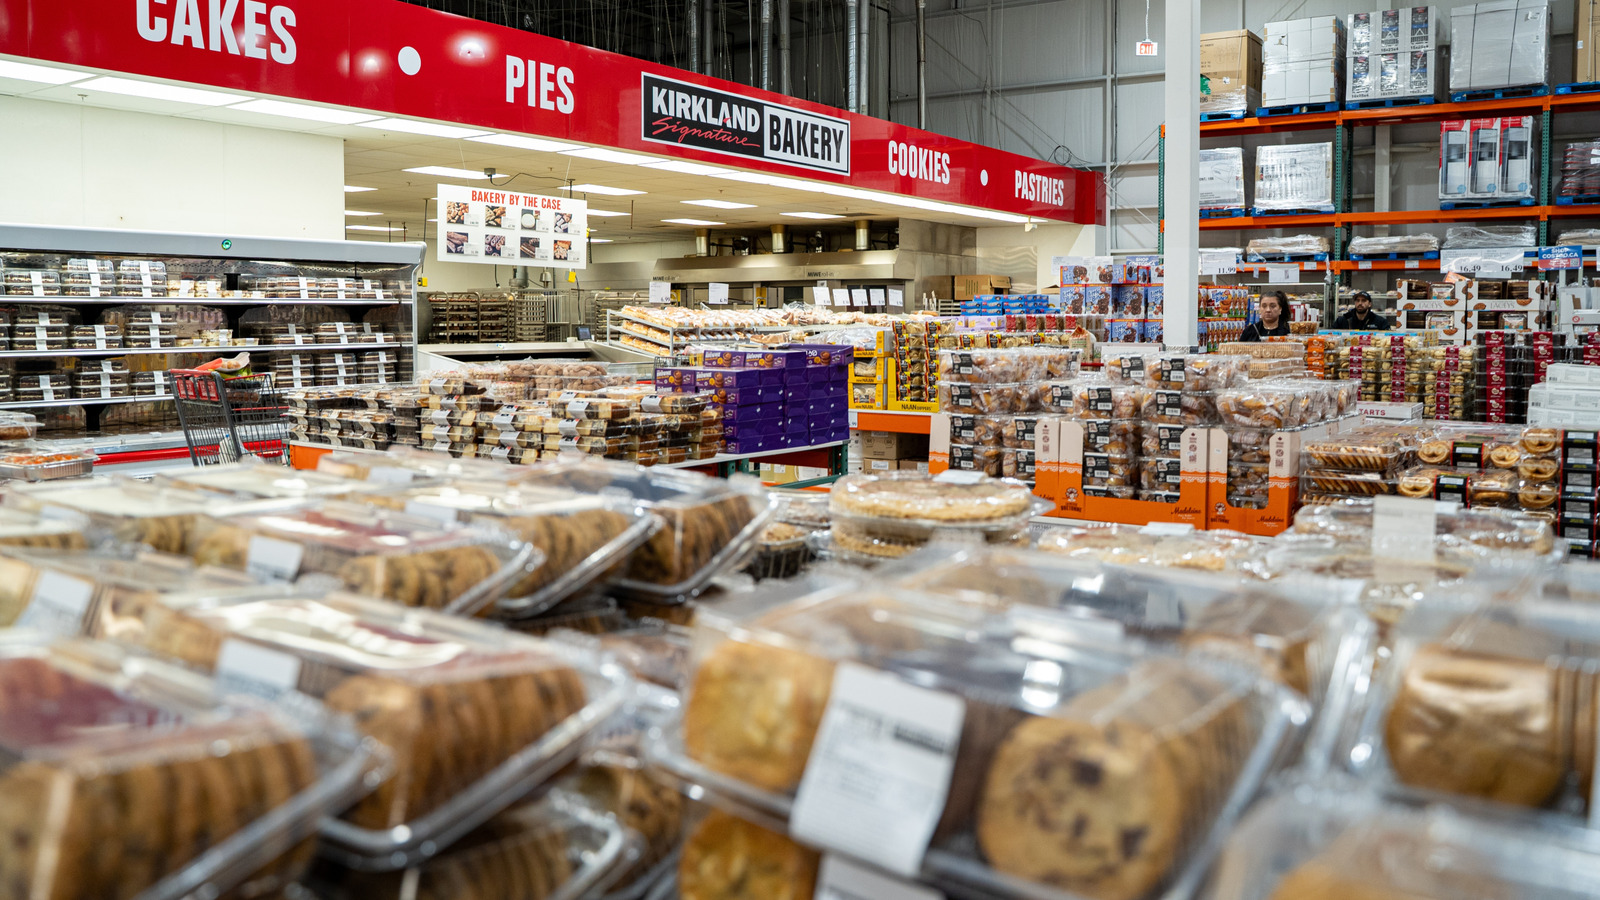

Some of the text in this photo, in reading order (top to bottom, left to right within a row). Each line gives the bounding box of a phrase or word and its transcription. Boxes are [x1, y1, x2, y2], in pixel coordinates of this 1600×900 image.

[136, 0, 297, 65] CAKES
[1140, 43, 1154, 55] EXIT
[506, 54, 575, 115] PIES
[652, 85, 761, 133] KIRKLAND
[652, 116, 760, 148] Signature
[769, 114, 844, 164] BAKERY
[888, 140, 951, 185] COOKIES
[471, 190, 561, 210] BAKERY BY THE CASE
[1014, 169, 1064, 207] PASTRIES
[1359, 408, 1385, 416] TARTS
